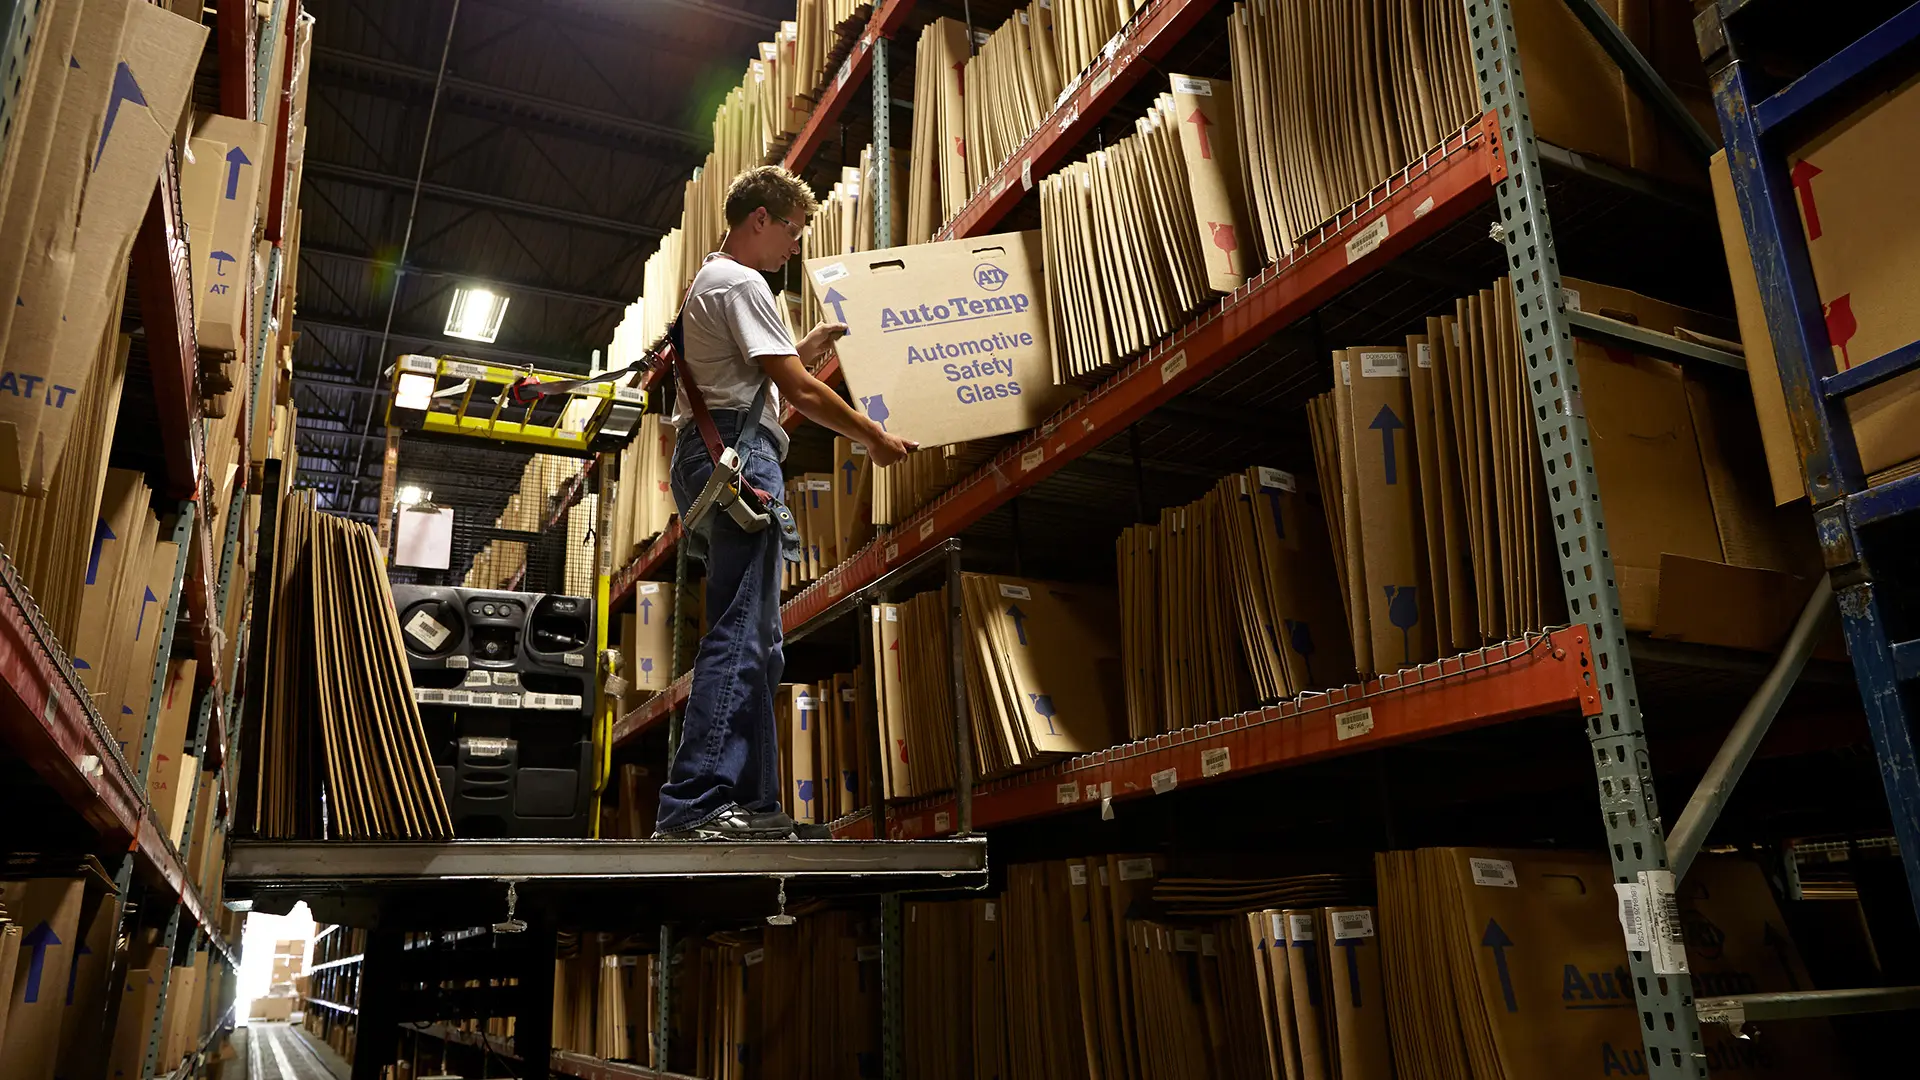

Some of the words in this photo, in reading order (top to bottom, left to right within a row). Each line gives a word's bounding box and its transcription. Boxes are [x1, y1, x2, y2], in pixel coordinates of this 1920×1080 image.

[210, 284, 229, 294] AT
[978, 268, 1005, 287] AT
[881, 293, 1029, 329] AutoTemp
[907, 332, 1033, 365] Automotive
[943, 358, 1013, 383] Safety
[0, 371, 43, 399] AT
[956, 381, 1022, 404] Glass
